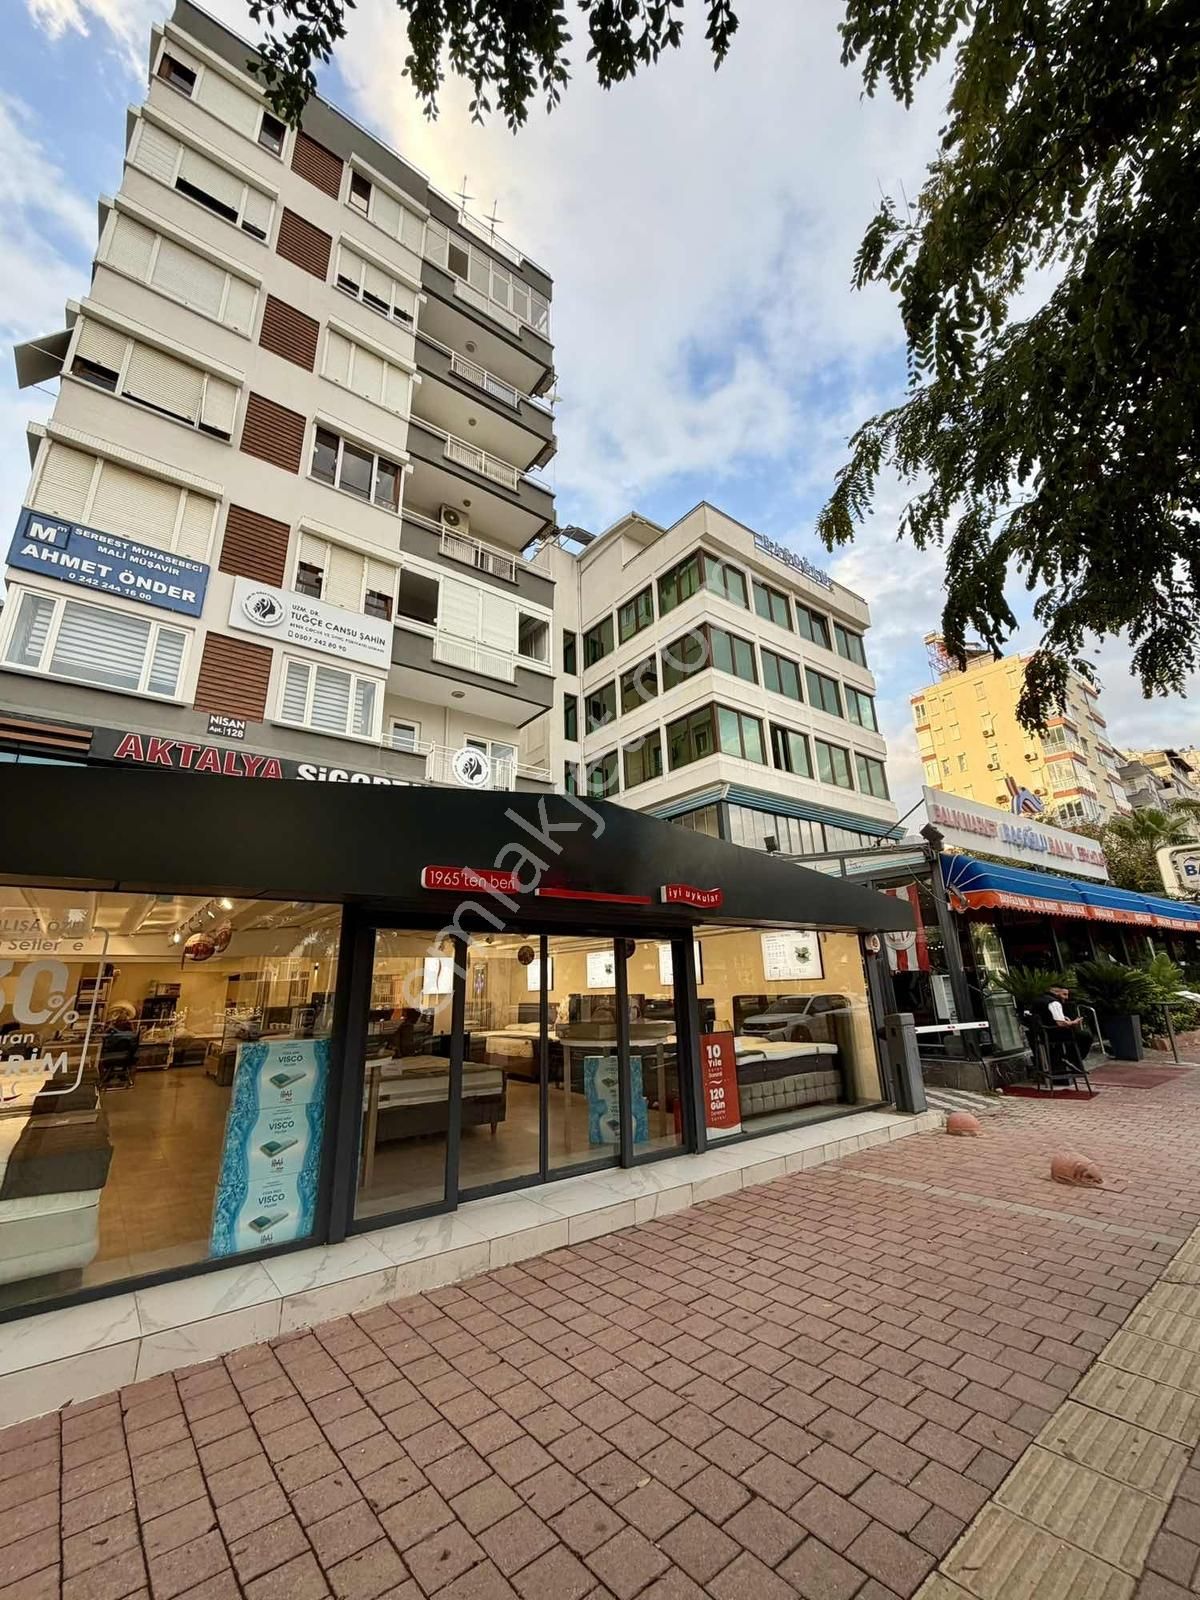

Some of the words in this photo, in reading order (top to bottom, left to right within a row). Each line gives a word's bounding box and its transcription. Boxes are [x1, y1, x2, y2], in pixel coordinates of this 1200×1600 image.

[75, 528, 129, 549] SERBEST
[132, 546, 204, 573] MUHASEBECİ
[97, 546, 127, 560] MALİ
[129, 556, 181, 576] MÜŞAVİR
[21, 544, 112, 578] AHMET
[119, 569, 196, 603] ÖNDER
[78, 575, 99, 586] 242
[101, 581, 121, 592] 244
[124, 587, 137, 596] 16
[139, 592, 152, 601] 00
[292, 604, 307, 613] UZM.
[291, 612, 323, 627] TUĞÇE
[325, 622, 357, 637] CANSU
[360, 632, 386, 646] ŞAHİN
[210, 715, 245, 730] NİSAN
[226, 728, 244, 738] 128
[113, 733, 283, 779] AKTALYA
[490, 875, 515, 889] beri
[668, 887, 682, 899] iyi
[685, 890, 718, 903] uykular
[0, 1033, 35, 1045] ran
[706, 1044, 721, 1059] 10
[278, 1055, 304, 1064] VISCO
[709, 1087, 725, 1101] 120
[710, 1100, 726, 1111] Gün
[269, 1120, 295, 1130] VISCO
[258, 1193, 285, 1206] VISCO
